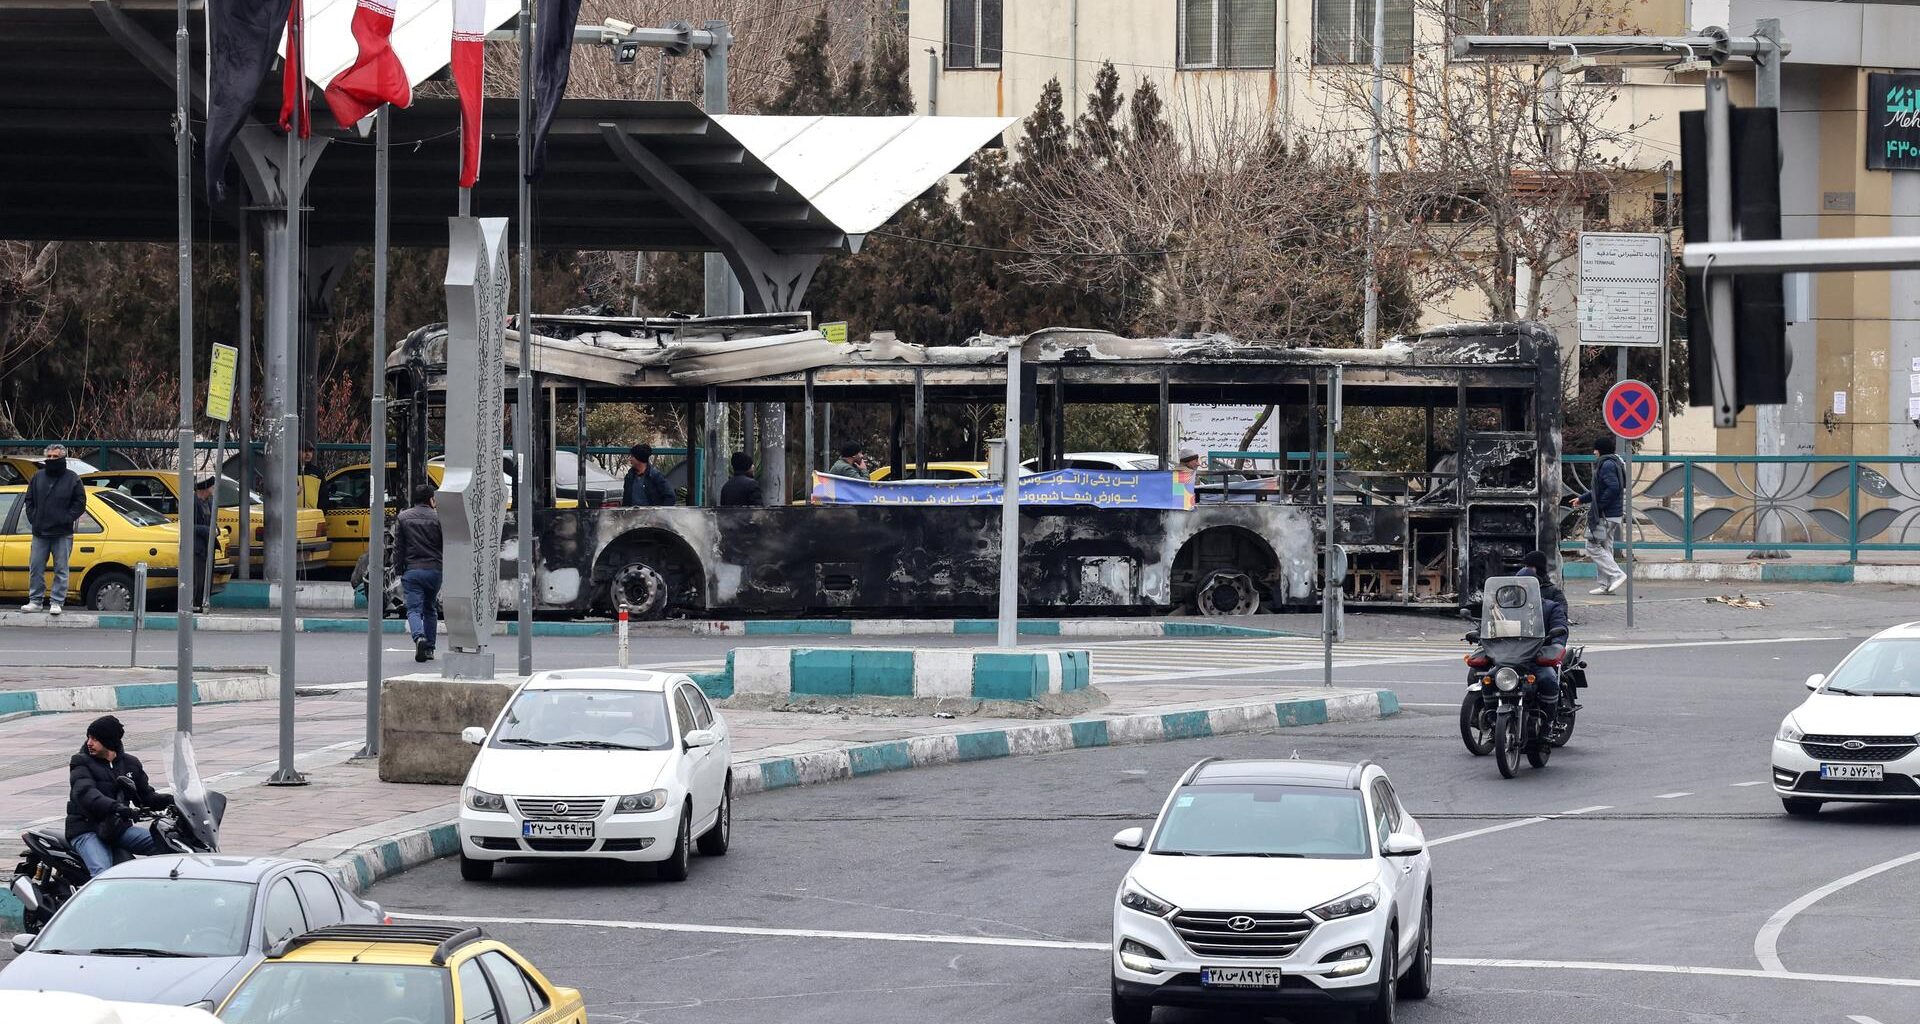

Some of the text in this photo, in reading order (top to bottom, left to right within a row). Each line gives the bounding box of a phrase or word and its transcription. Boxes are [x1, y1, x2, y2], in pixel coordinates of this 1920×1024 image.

[1883, 109, 1920, 128] Meh
[1090, 474, 1111, 487] یکی
[1112, 475, 1139, 488] این
[902, 494, 937, 504] شده
[938, 492, 993, 504] خریداری
[1060, 492, 1092, 503] شما
[1094, 493, 1138, 503] عوارض
